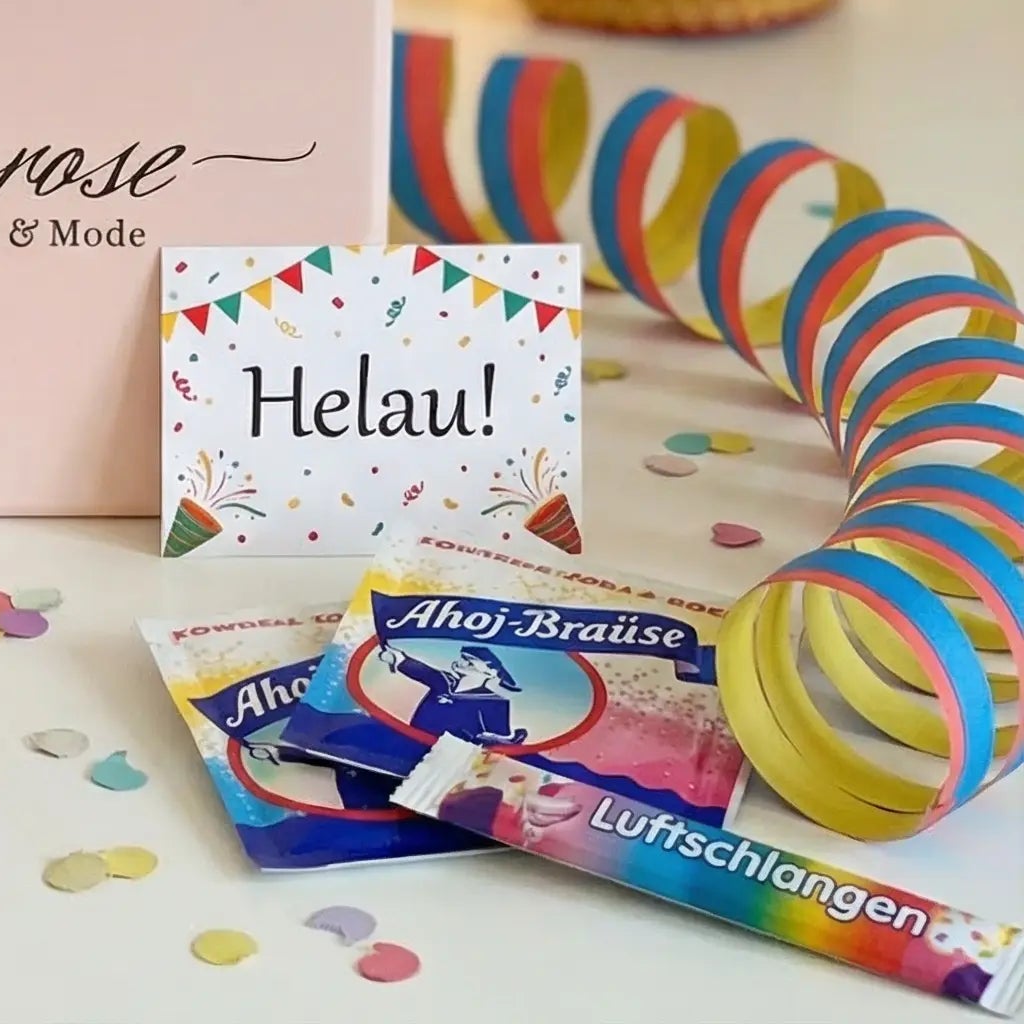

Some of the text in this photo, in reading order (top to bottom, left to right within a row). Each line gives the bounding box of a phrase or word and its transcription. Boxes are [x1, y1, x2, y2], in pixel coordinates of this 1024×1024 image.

[9, 220, 39, 248] &
[50, 219, 146, 249] Mode
[242, 353, 496, 438] Helau!
[386, 598, 686, 649] Ahoj-Braüse
[589, 796, 929, 937] Luftschlangen
